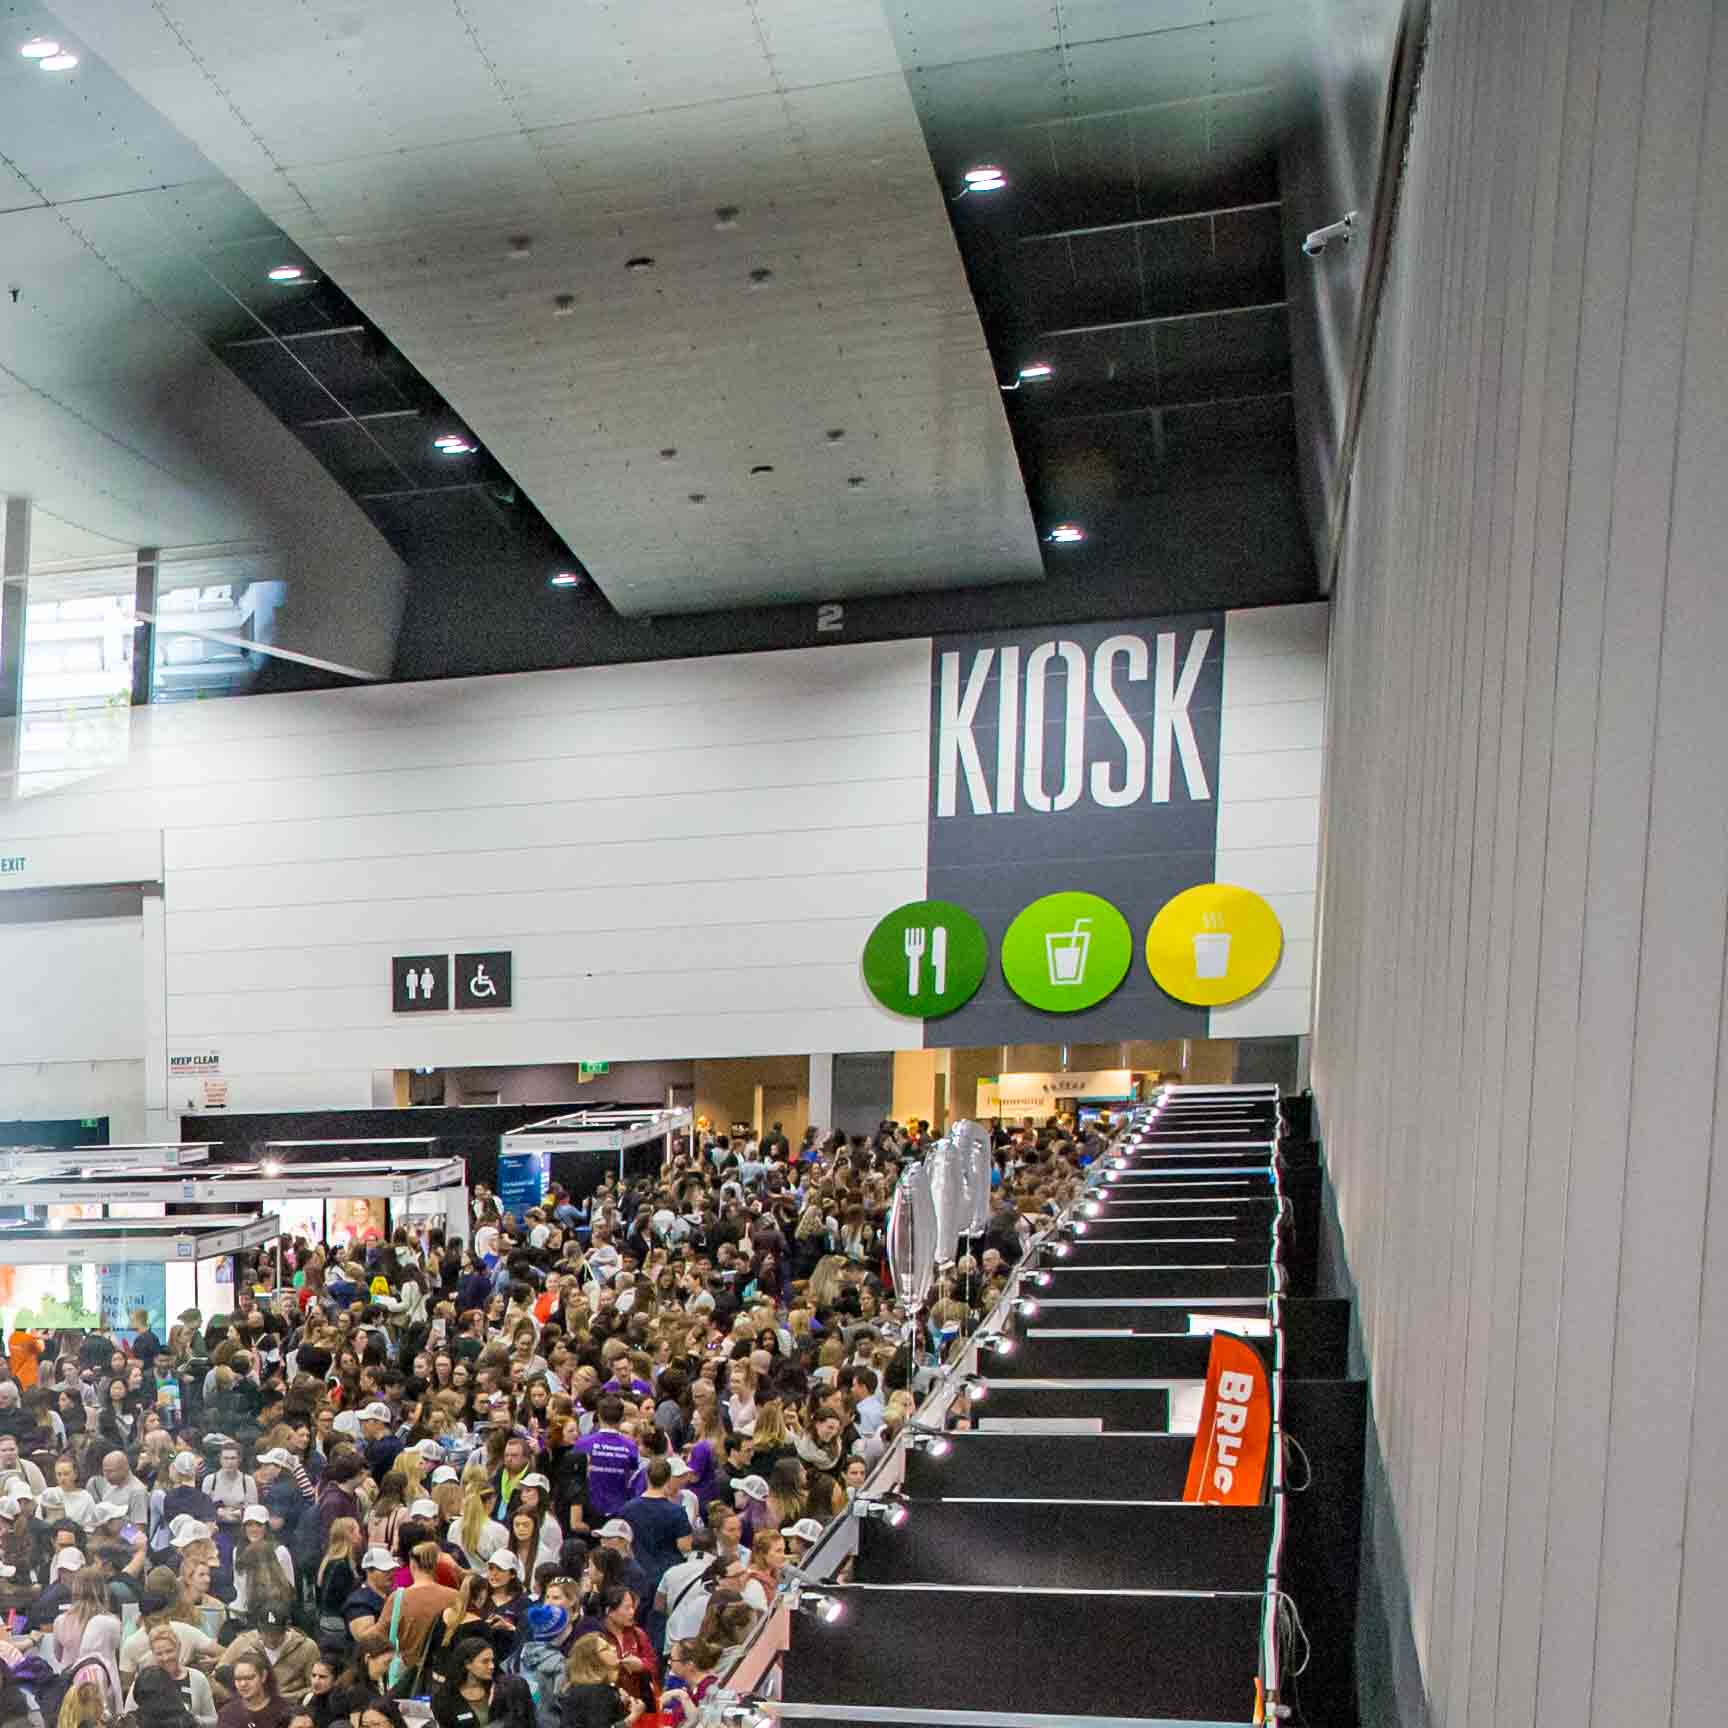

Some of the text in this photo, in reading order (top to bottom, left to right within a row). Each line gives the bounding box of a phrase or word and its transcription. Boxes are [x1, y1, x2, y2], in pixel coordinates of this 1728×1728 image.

[816, 604, 843, 632] 2
[936, 629, 1214, 818] KIOSK
[1, 857, 25, 872] EXIT
[171, 1055, 219, 1065] KEEP CLEAR
